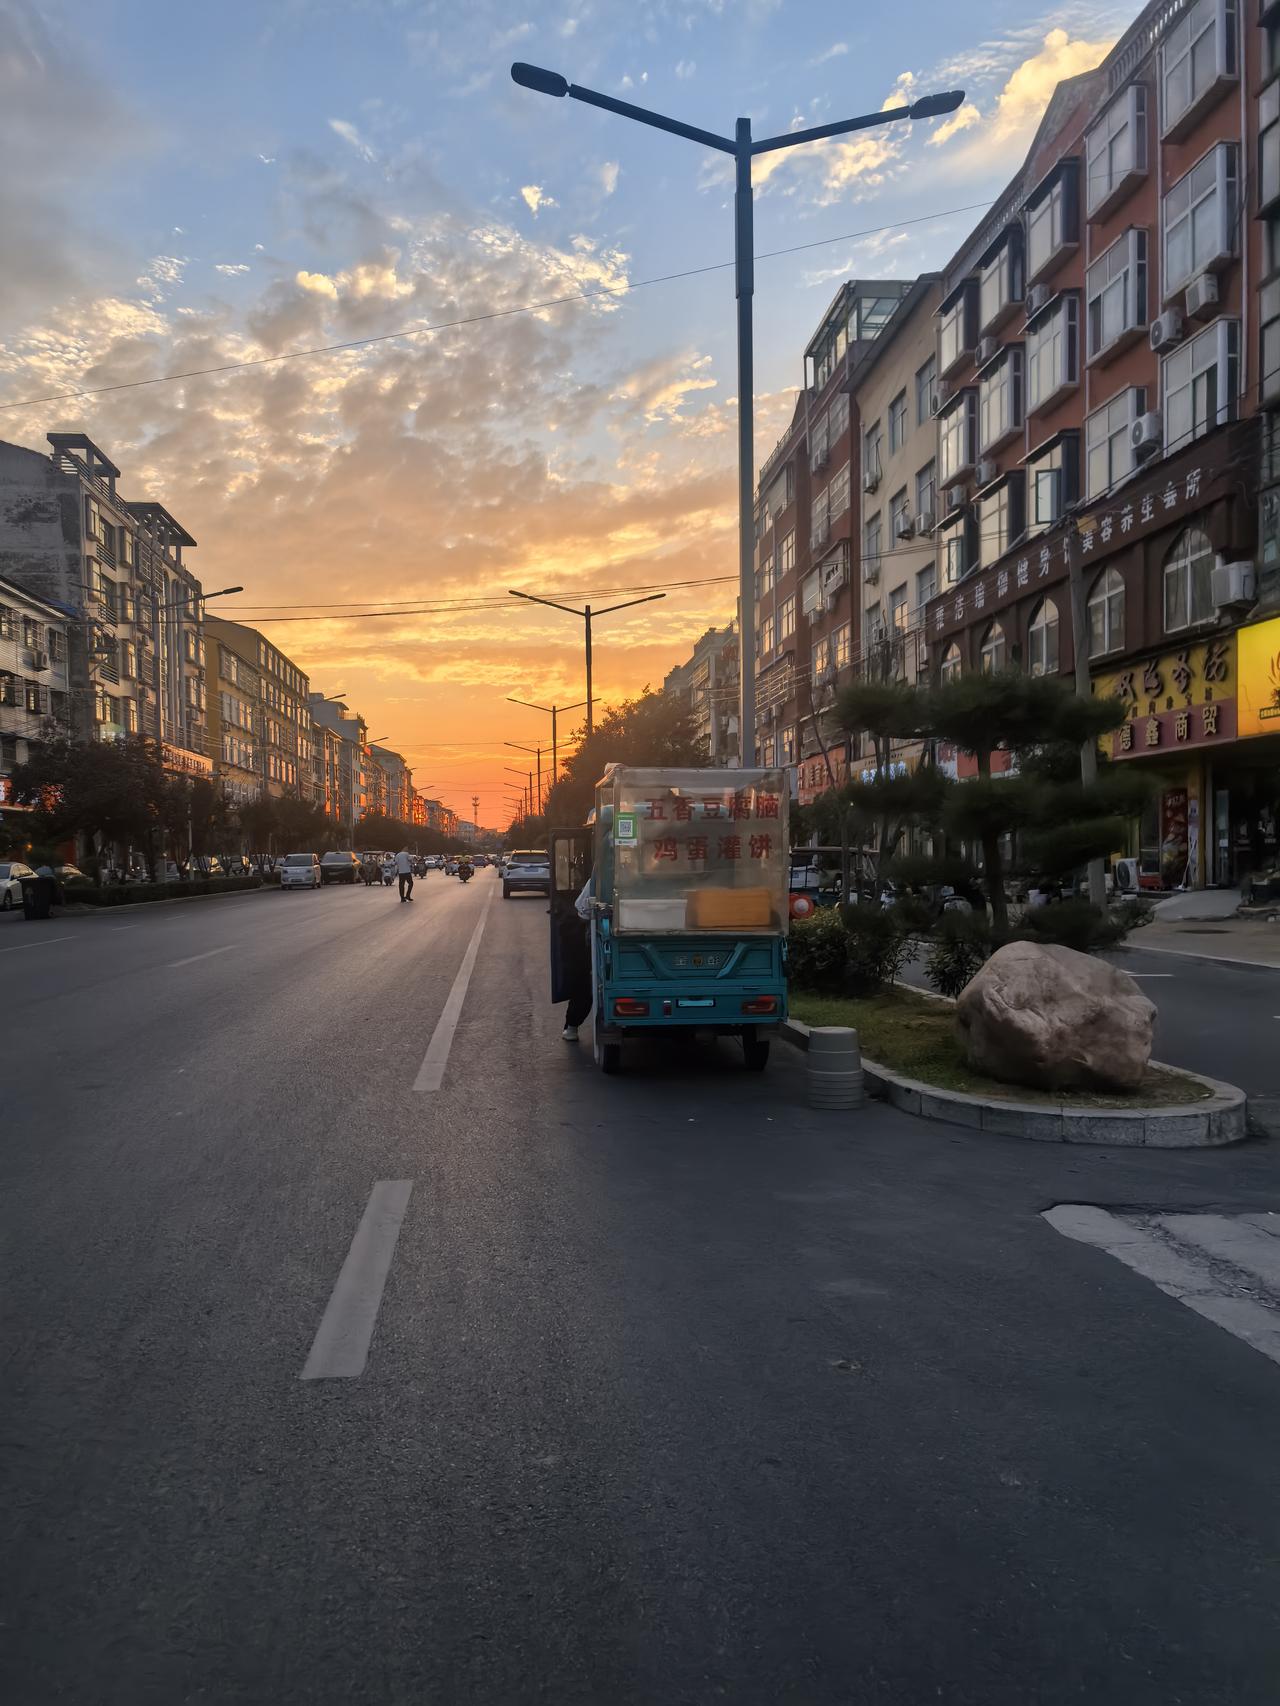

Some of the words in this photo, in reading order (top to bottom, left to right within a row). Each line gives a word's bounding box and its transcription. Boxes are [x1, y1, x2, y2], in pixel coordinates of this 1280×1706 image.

[1118, 705, 1218, 751] 德鑫商贸
[643, 791, 779, 821] 五香豆腐脑
[654, 834, 773, 861] 鸡蛋灌饼
